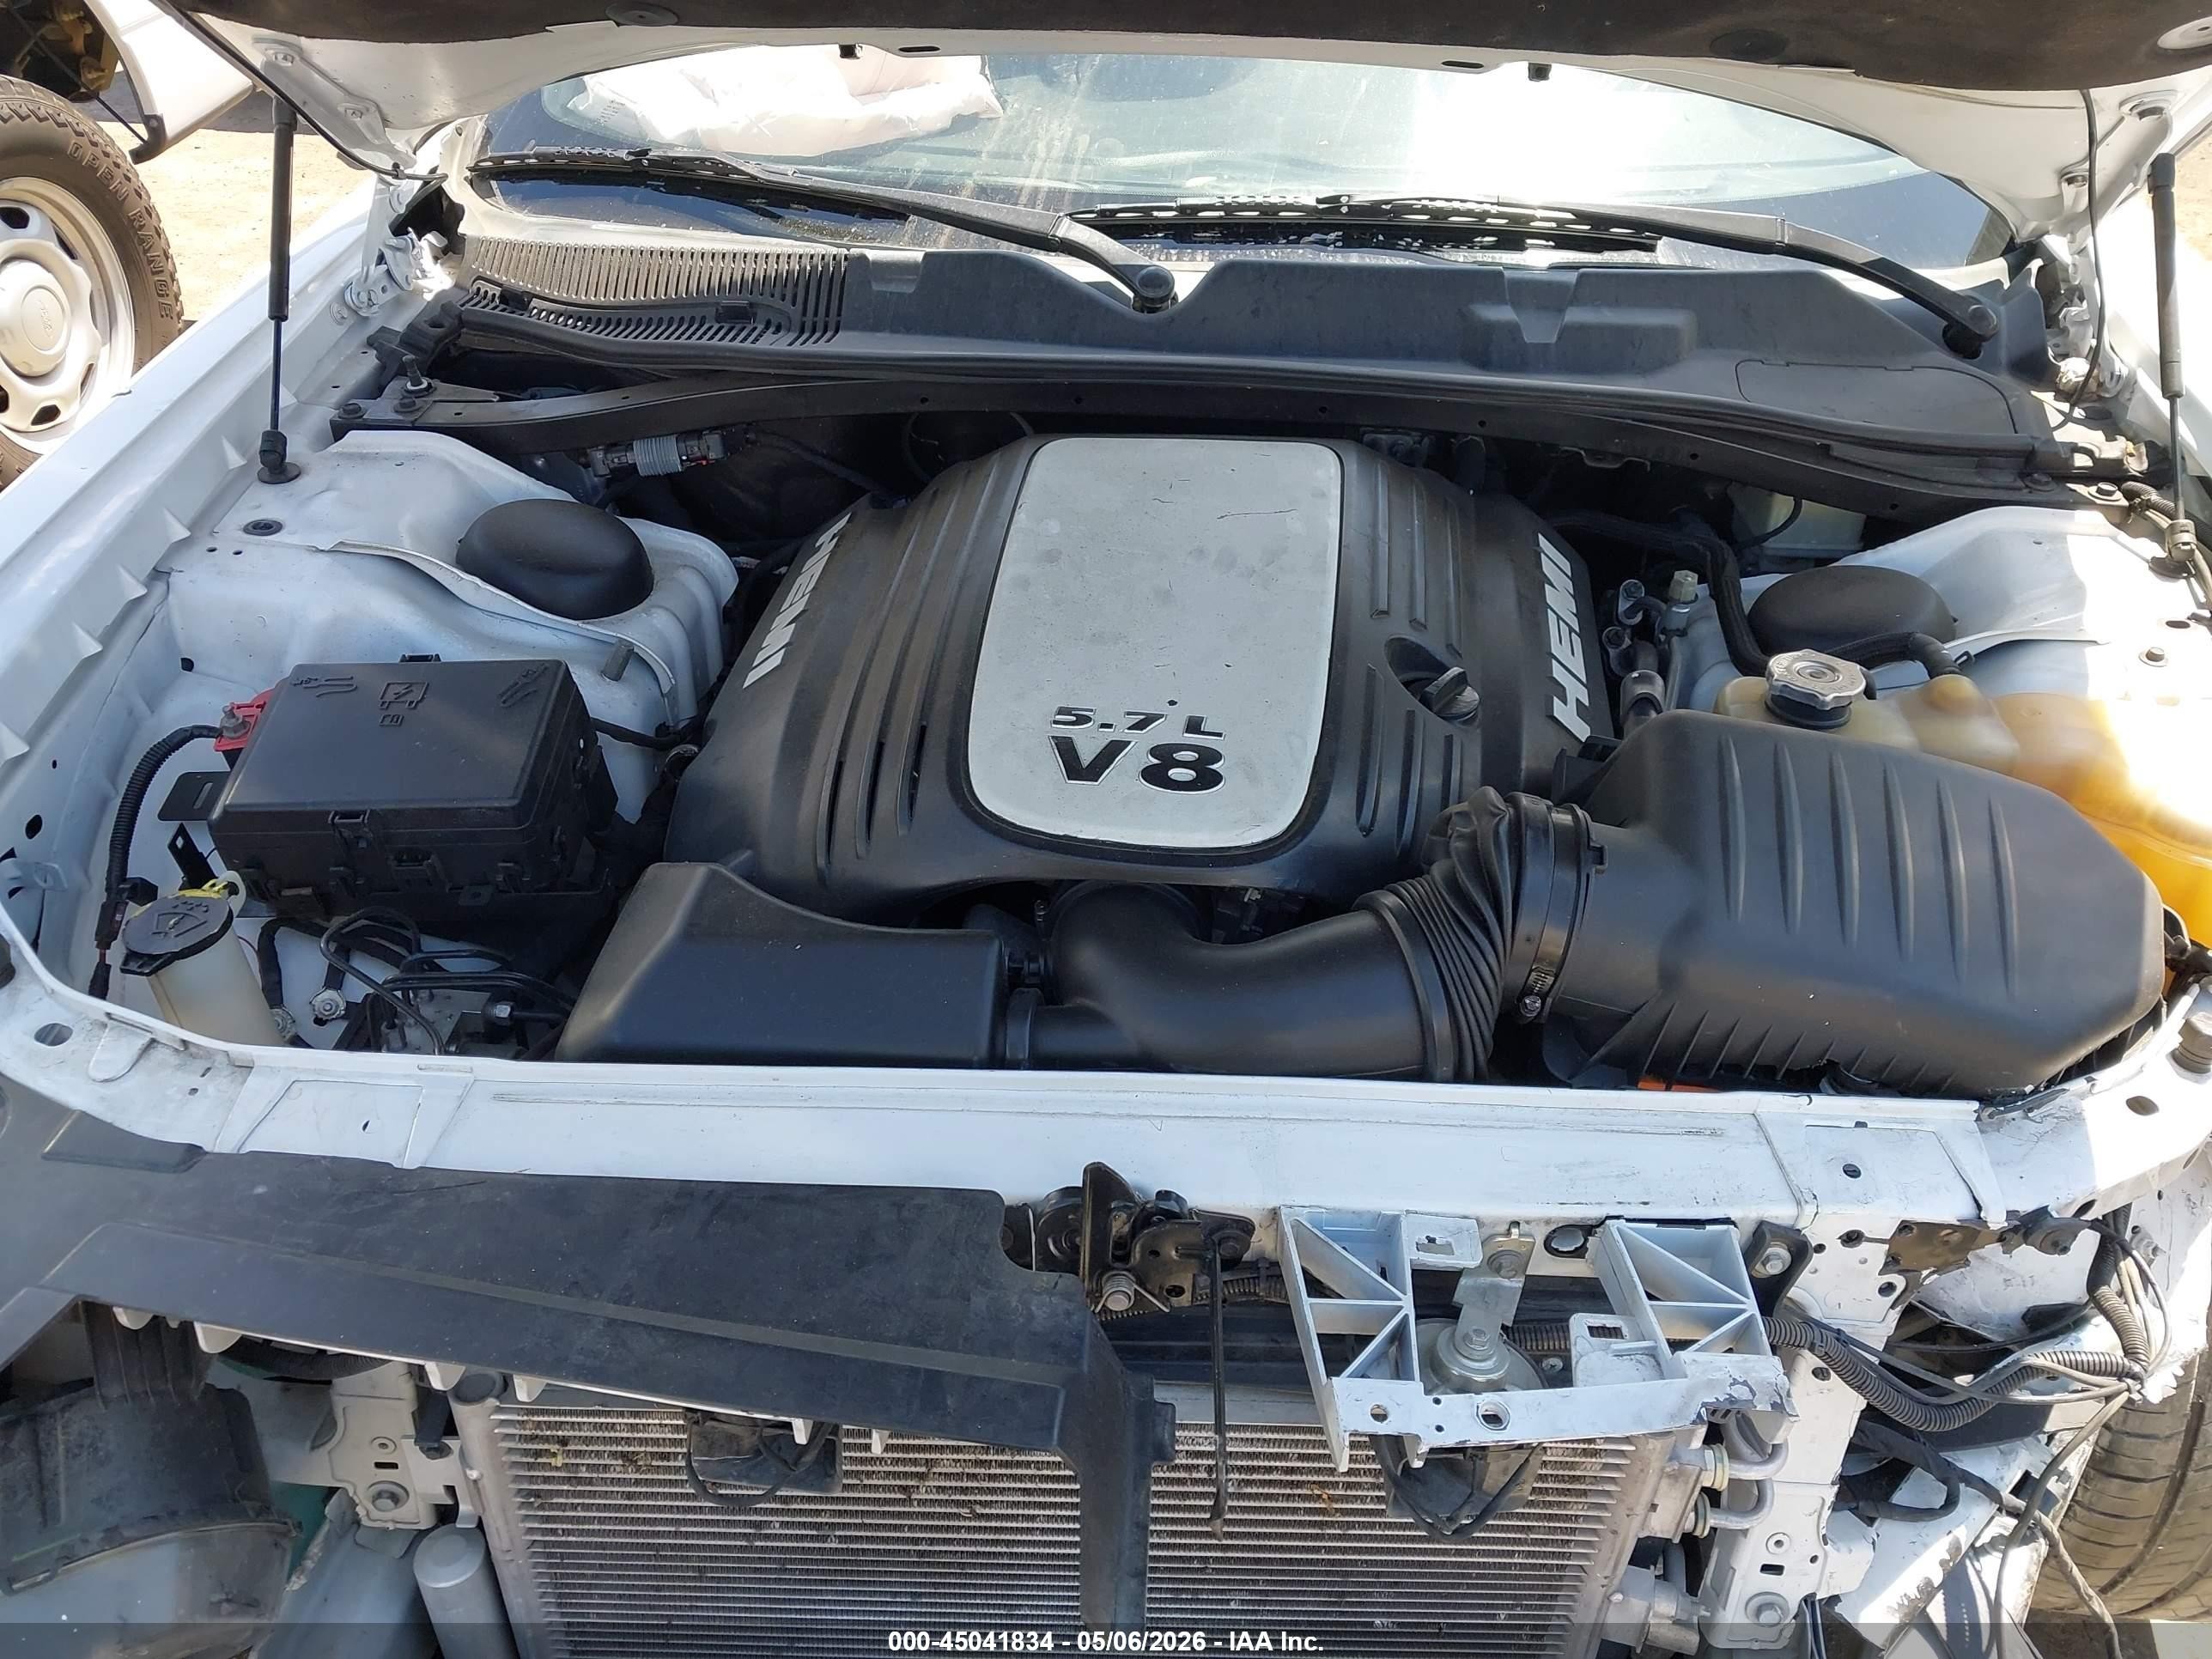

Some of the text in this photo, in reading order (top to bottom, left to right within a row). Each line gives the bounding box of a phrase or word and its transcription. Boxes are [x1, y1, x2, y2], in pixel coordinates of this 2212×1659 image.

[67, 141, 173, 319] OPEN RANGE
[742, 512, 852, 690] HEMI
[1537, 532, 1591, 743] HEMI
[1047, 734, 1226, 795] V8
